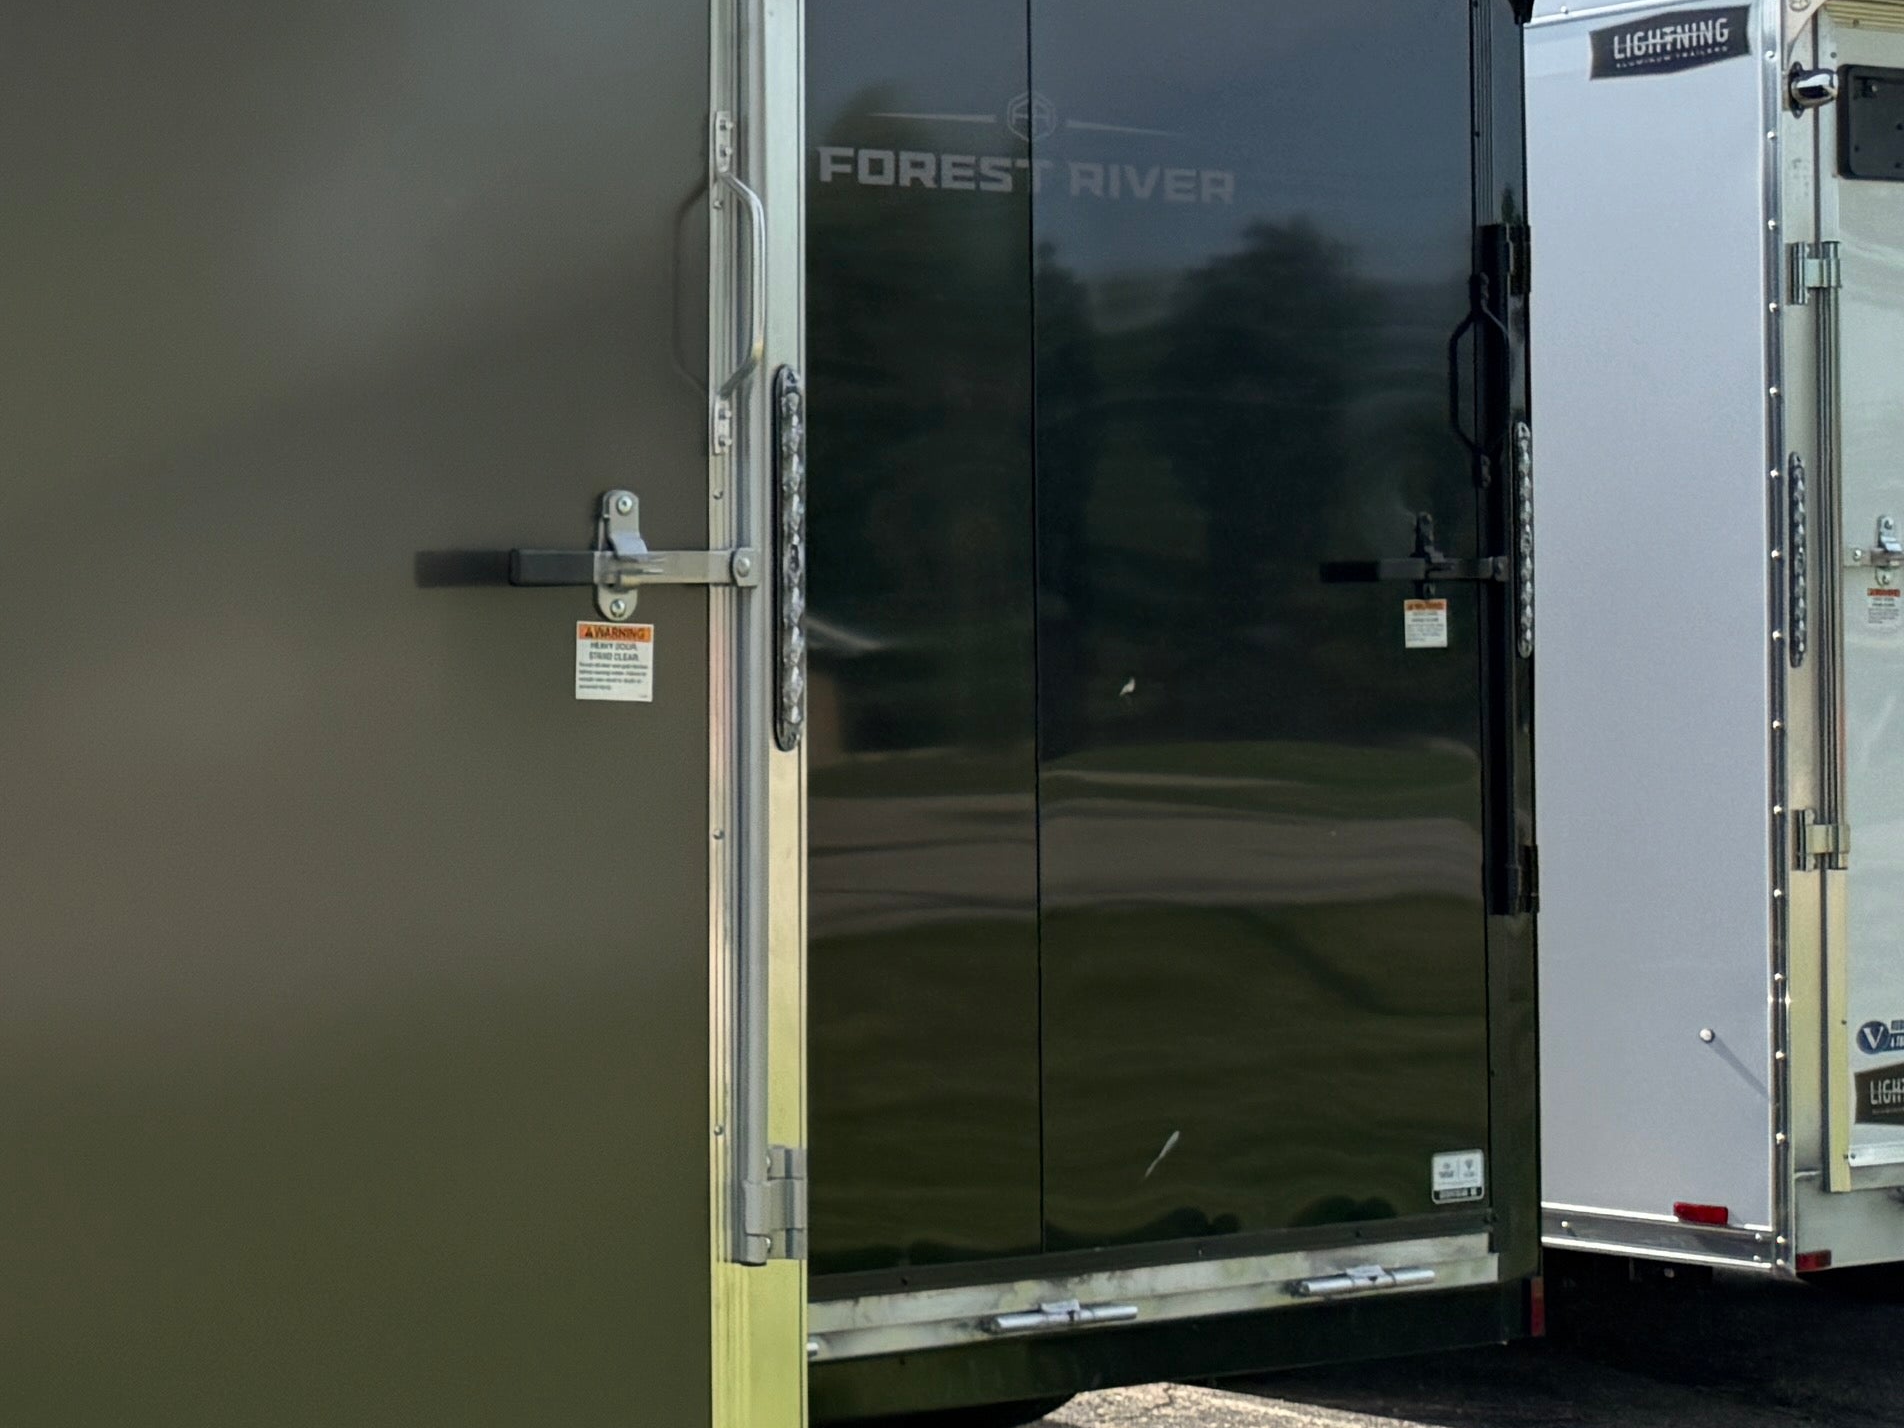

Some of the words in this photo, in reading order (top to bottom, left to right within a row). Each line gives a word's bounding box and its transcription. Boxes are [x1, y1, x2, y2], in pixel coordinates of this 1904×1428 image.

[1613, 18, 1730, 60] LIGHTNING
[816, 145, 1051, 195] FOREST
[1067, 160, 1236, 205] RIVER
[1863, 1025, 1884, 1049] V
